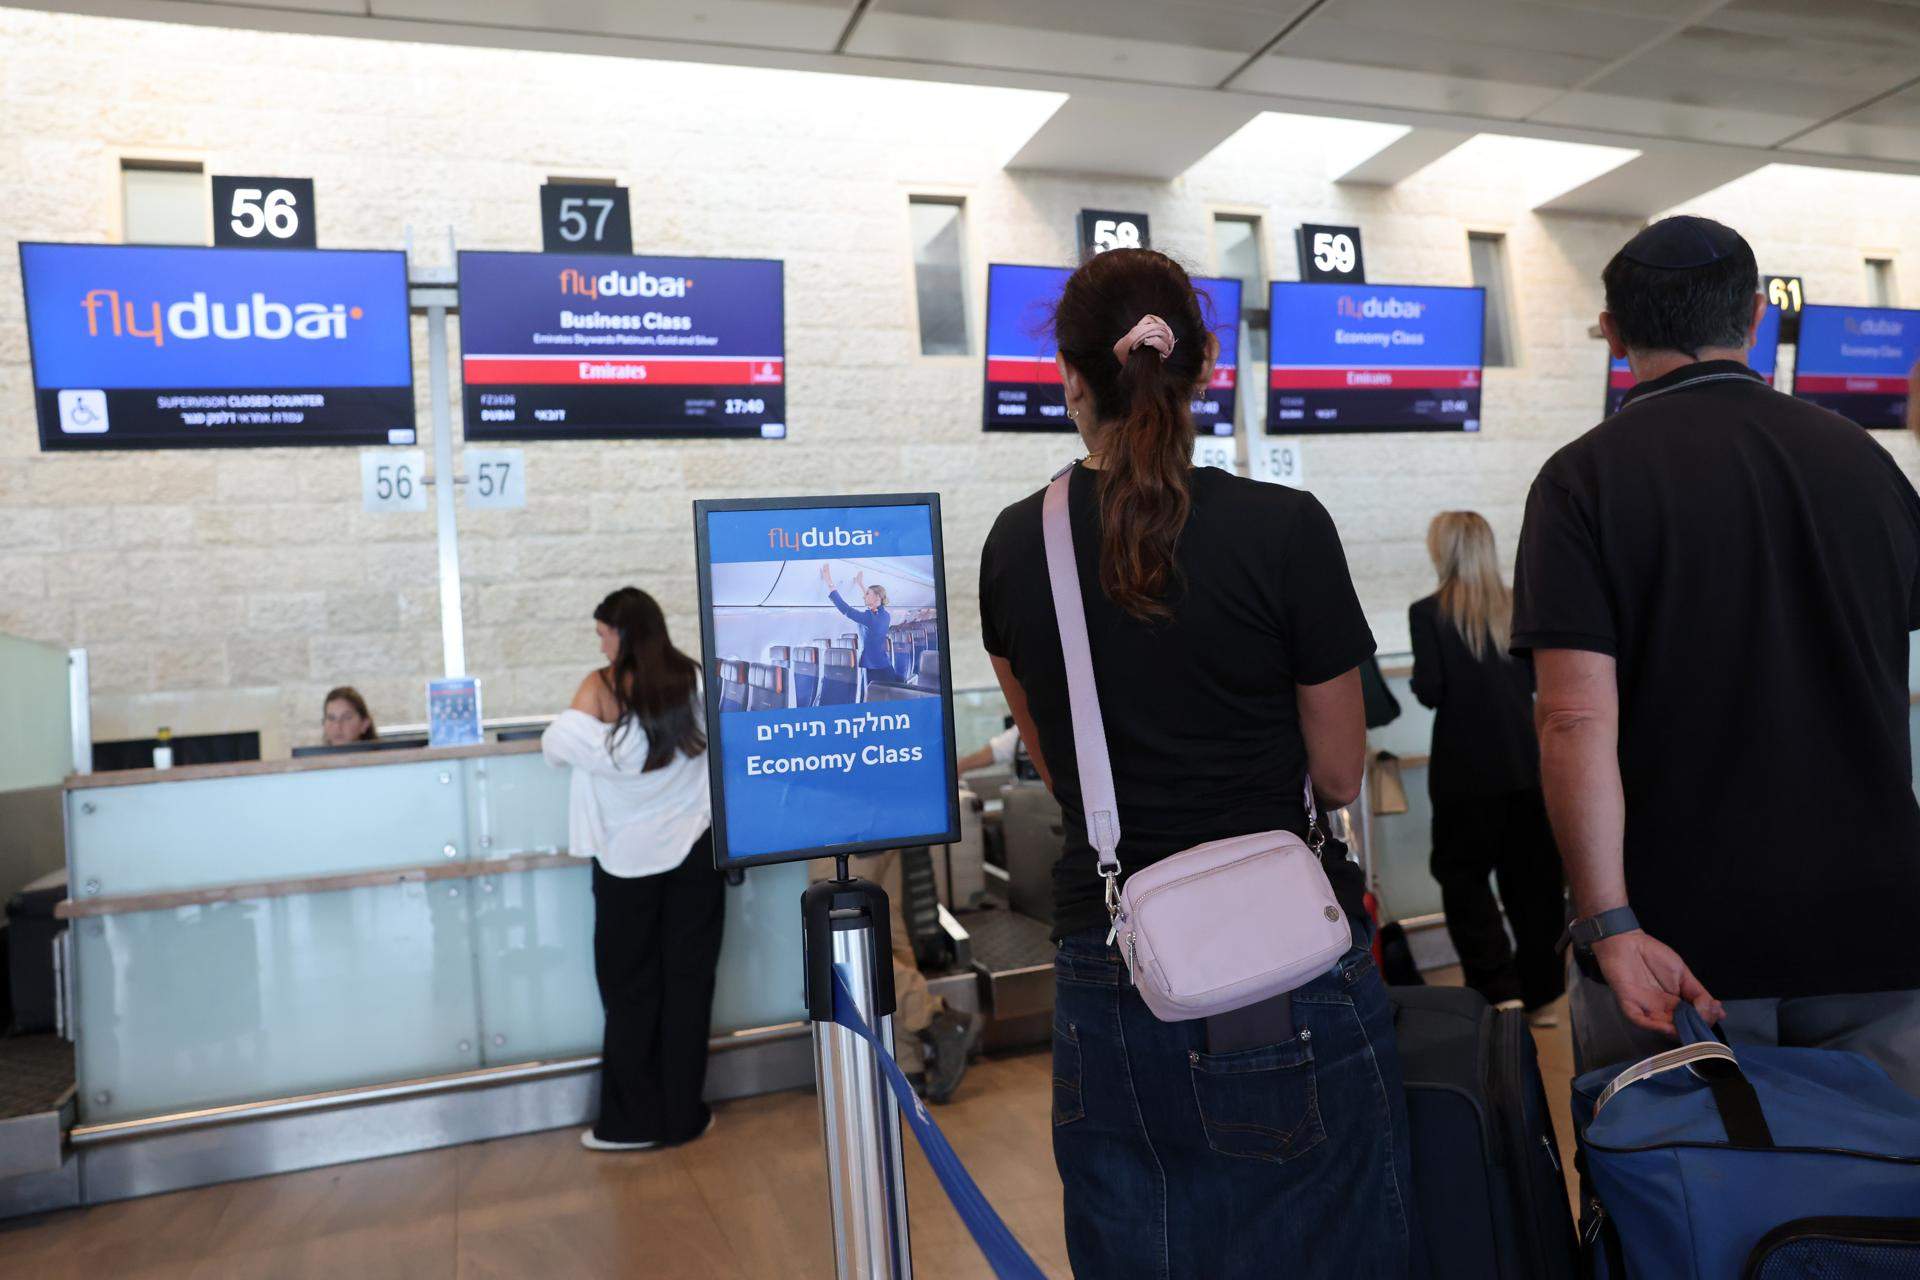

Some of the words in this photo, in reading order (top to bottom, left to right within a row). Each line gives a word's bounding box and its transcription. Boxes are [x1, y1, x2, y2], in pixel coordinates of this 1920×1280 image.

[230, 188, 299, 239] 56
[560, 198, 614, 241] 57
[1313, 232, 1355, 273] 59
[560, 268, 693, 300] flydubai
[1769, 278, 1801, 312] 61
[80, 289, 363, 347] flydubai
[560, 310, 641, 330] Business
[643, 311, 692, 331] Class
[579, 362, 647, 380] Emirates
[228, 394, 271, 408] CLOSED
[271, 393, 325, 408] COUNTER
[725, 399, 765, 414] 17:40
[1270, 449, 1294, 476] 59
[377, 465, 412, 499] 56
[478, 463, 511, 497] 57
[768, 526, 880, 552] flydubai
[757, 720, 826, 741] תיירים
[834, 712, 911, 738] מחלקת
[747, 751, 856, 776] Economy
[861, 745, 923, 765] Class
